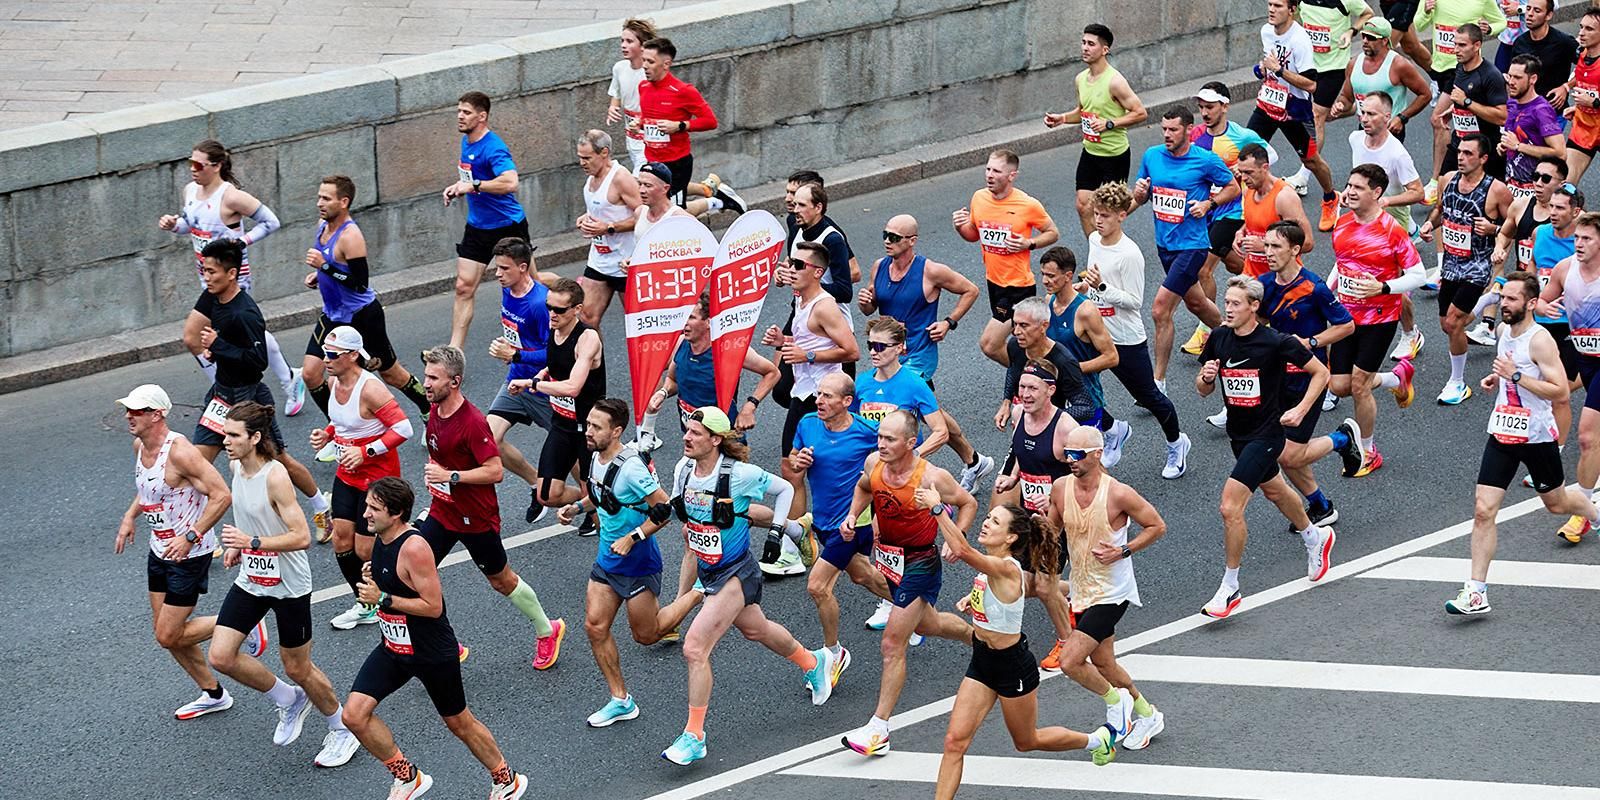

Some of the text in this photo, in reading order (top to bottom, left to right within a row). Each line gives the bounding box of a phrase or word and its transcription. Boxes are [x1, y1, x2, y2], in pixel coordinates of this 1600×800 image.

[1264, 88, 1285, 102] 9718
[1154, 195, 1184, 210] 11400
[728, 229, 770, 251] МАРАФОН
[983, 230, 1007, 242] 2977
[1445, 229, 1467, 244] 5559
[649, 239, 702, 251] МАРАФОН
[729, 239, 765, 260] МОСКВА
[649, 247, 693, 260] МОСКВА
[636, 266, 697, 303] 0:39
[717, 257, 771, 304] 0:39
[637, 316, 659, 331] 3:54
[1226, 379, 1254, 391] 8299
[1496, 414, 1528, 431] 11025
[144, 513, 165, 525] 34
[688, 530, 719, 547] 25589
[247, 556, 275, 571] 2904
